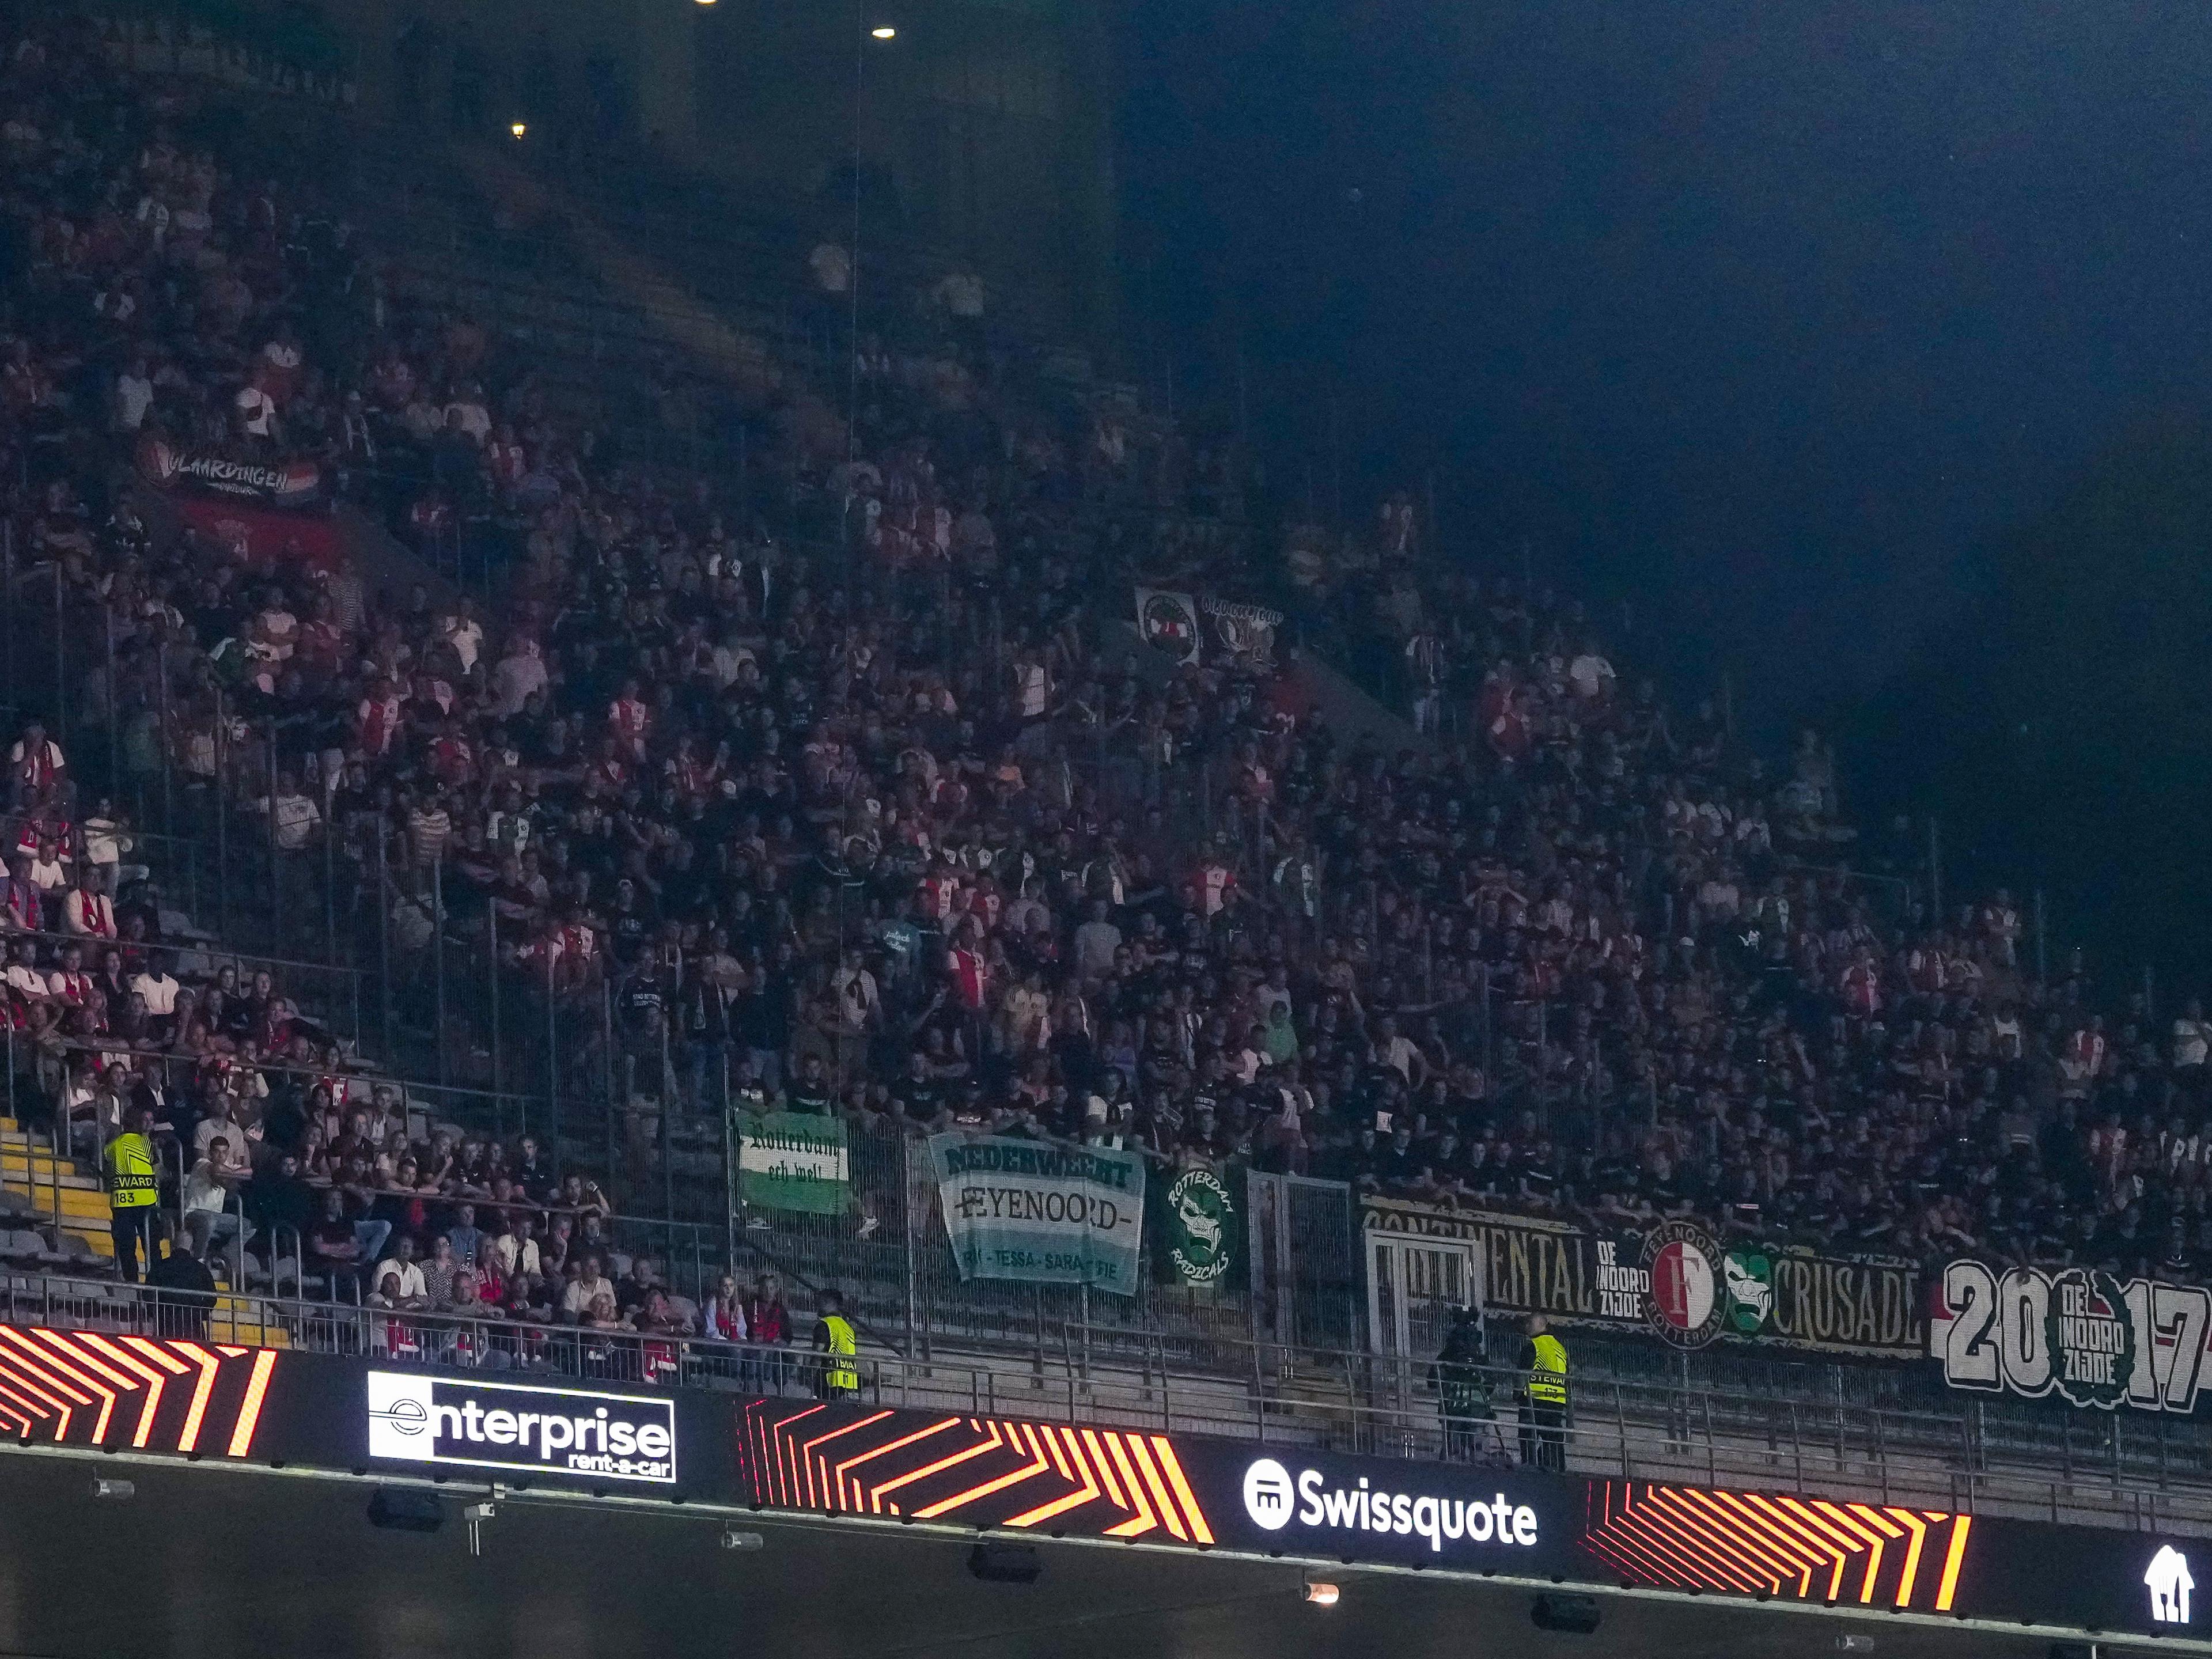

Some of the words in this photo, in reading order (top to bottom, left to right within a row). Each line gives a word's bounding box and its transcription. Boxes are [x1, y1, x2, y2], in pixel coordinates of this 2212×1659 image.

[169, 453, 287, 490] VLAARDINGEN
[116, 1192, 134, 1203] 183
[1168, 1171, 1234, 1213] ROTTERDAM
[995, 1249, 1035, 1267] TESSA
[1044, 1253, 1083, 1270] SARA
[1171, 1248, 1229, 1280] RADICALS
[1596, 1241, 1616, 1265] DE
[1643, 1225, 1721, 1272] FEYENOORD
[1599, 1290, 1642, 1319] ZIJDE
[1773, 1259, 1922, 1345] CRUSADE
[2061, 1284, 2086, 1316] DE
[1647, 1301, 1722, 1344] ROTTERDAM
[1944, 1260, 2054, 1396] 20
[2122, 1278, 2211, 1413] 17
[2062, 1349, 2116, 1383] ZIJDE
[389, 1399, 671, 1459] enterprise
[568, 1453, 671, 1477] rent-a-car
[1298, 1469, 1537, 1551] Swissquote
